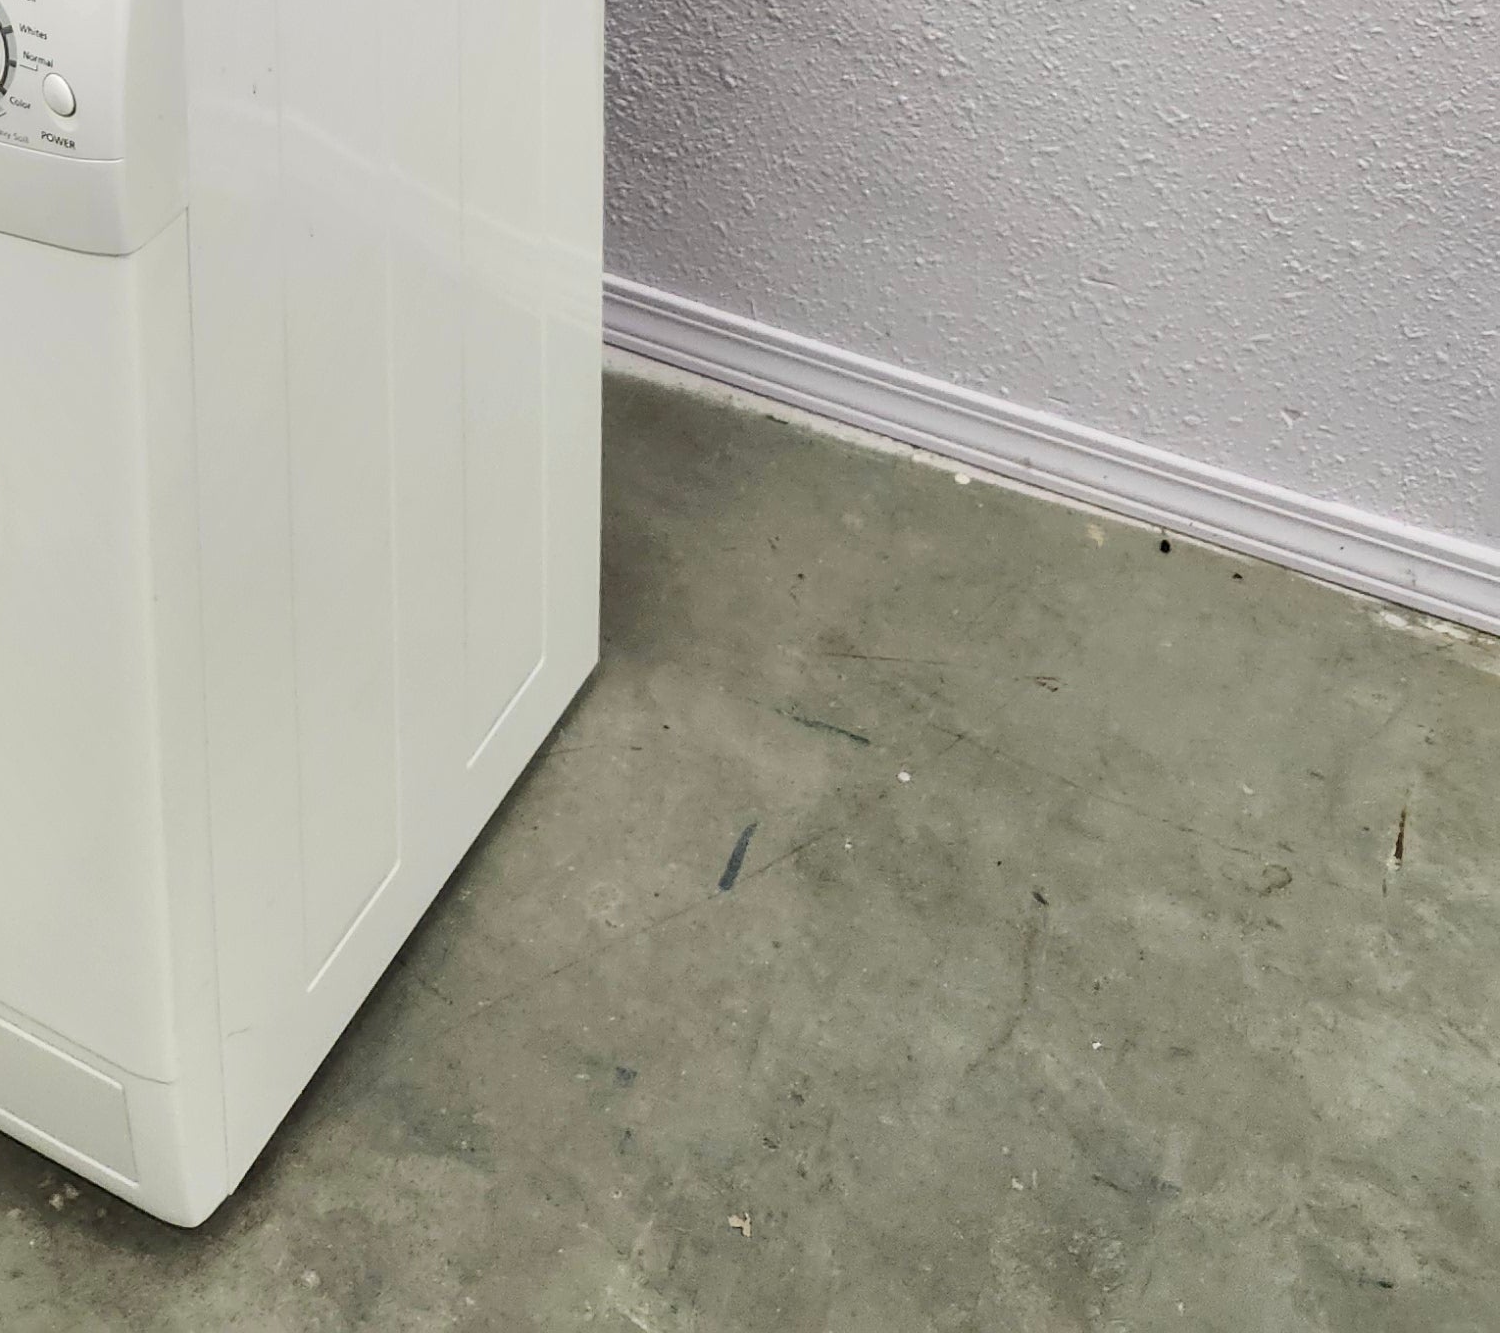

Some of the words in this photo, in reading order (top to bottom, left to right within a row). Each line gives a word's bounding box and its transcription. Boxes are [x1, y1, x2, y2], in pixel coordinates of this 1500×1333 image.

[19, 23, 49, 41] Whites
[22, 50, 54, 69] Normal
[9, 96, 32, 111] Color
[12, 131, 30, 145] Soil
[41, 131, 76, 151] POWER
